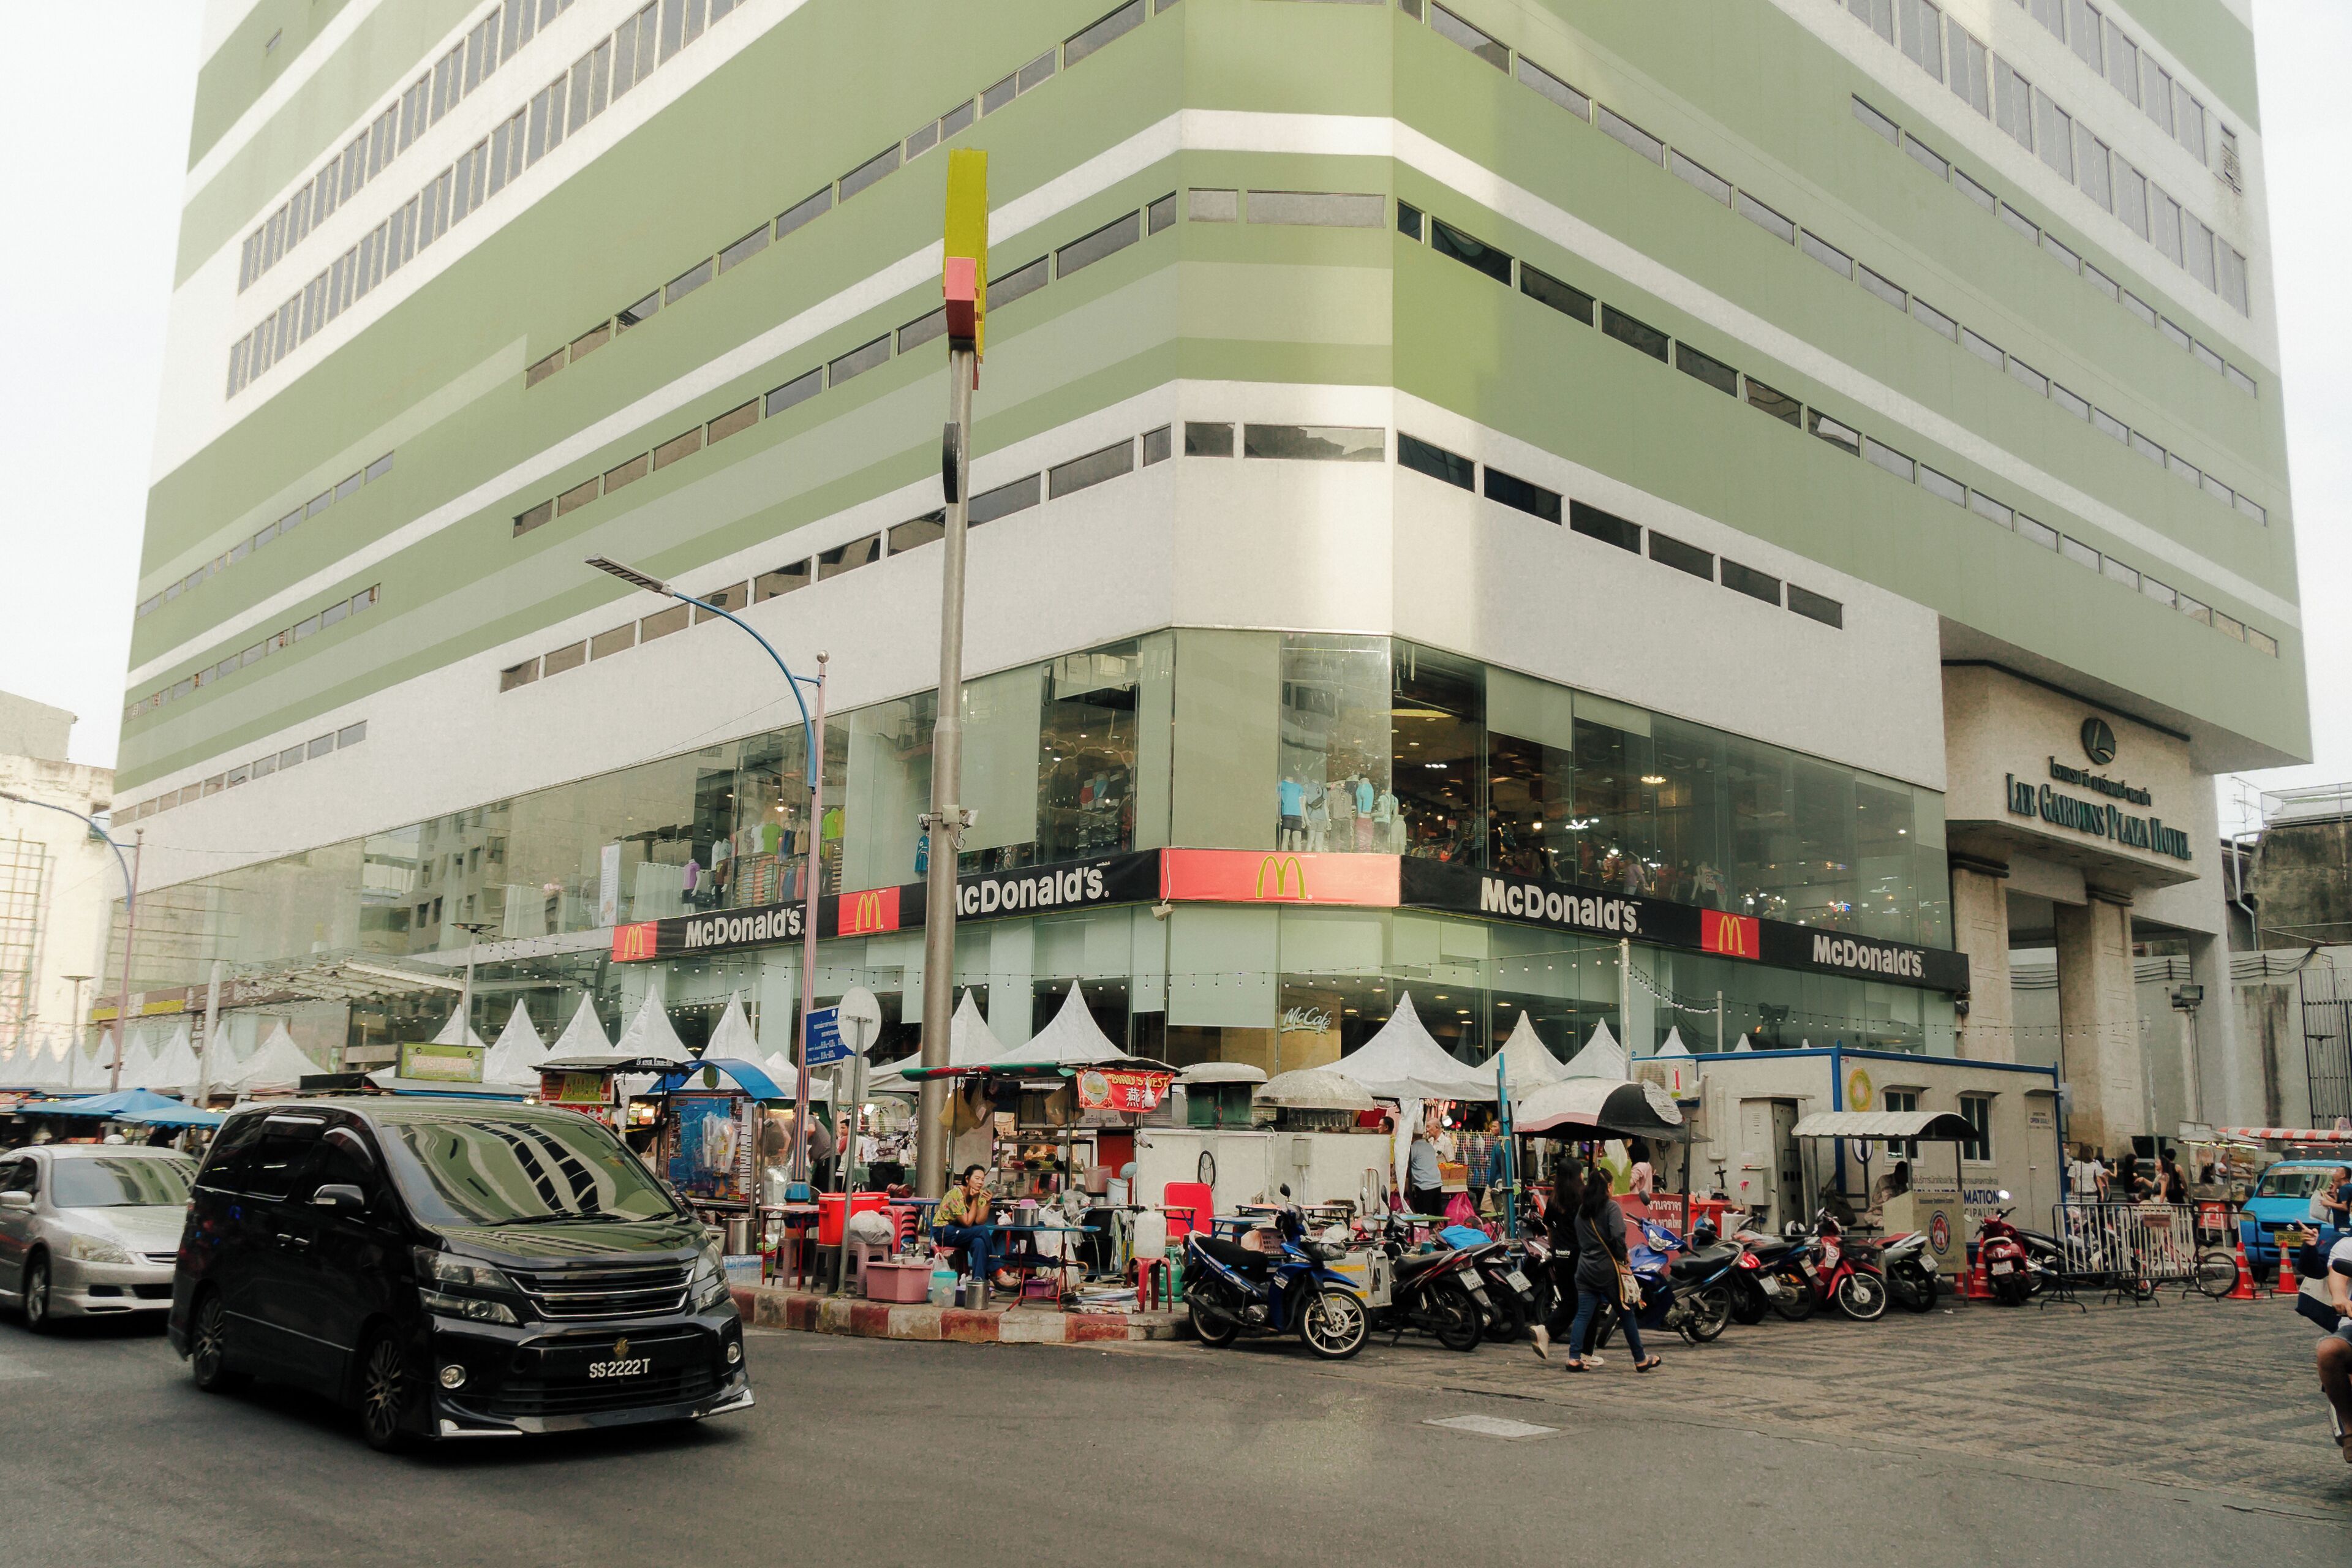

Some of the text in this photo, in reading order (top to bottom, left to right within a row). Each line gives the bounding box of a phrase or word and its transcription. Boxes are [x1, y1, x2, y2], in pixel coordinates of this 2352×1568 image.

[2005, 772, 2192, 861] LEE GARDENS PLAZA HOTEL
[956, 866, 1103, 916] cDonald's
[1480, 876, 1637, 933] McDonald's
[685, 908, 801, 948] McDonald's
[1813, 935, 1923, 978] McDonald's
[1283, 1006, 1333, 1033] McCafé
[1112, 1074, 1144, 1086] BIRD'S
